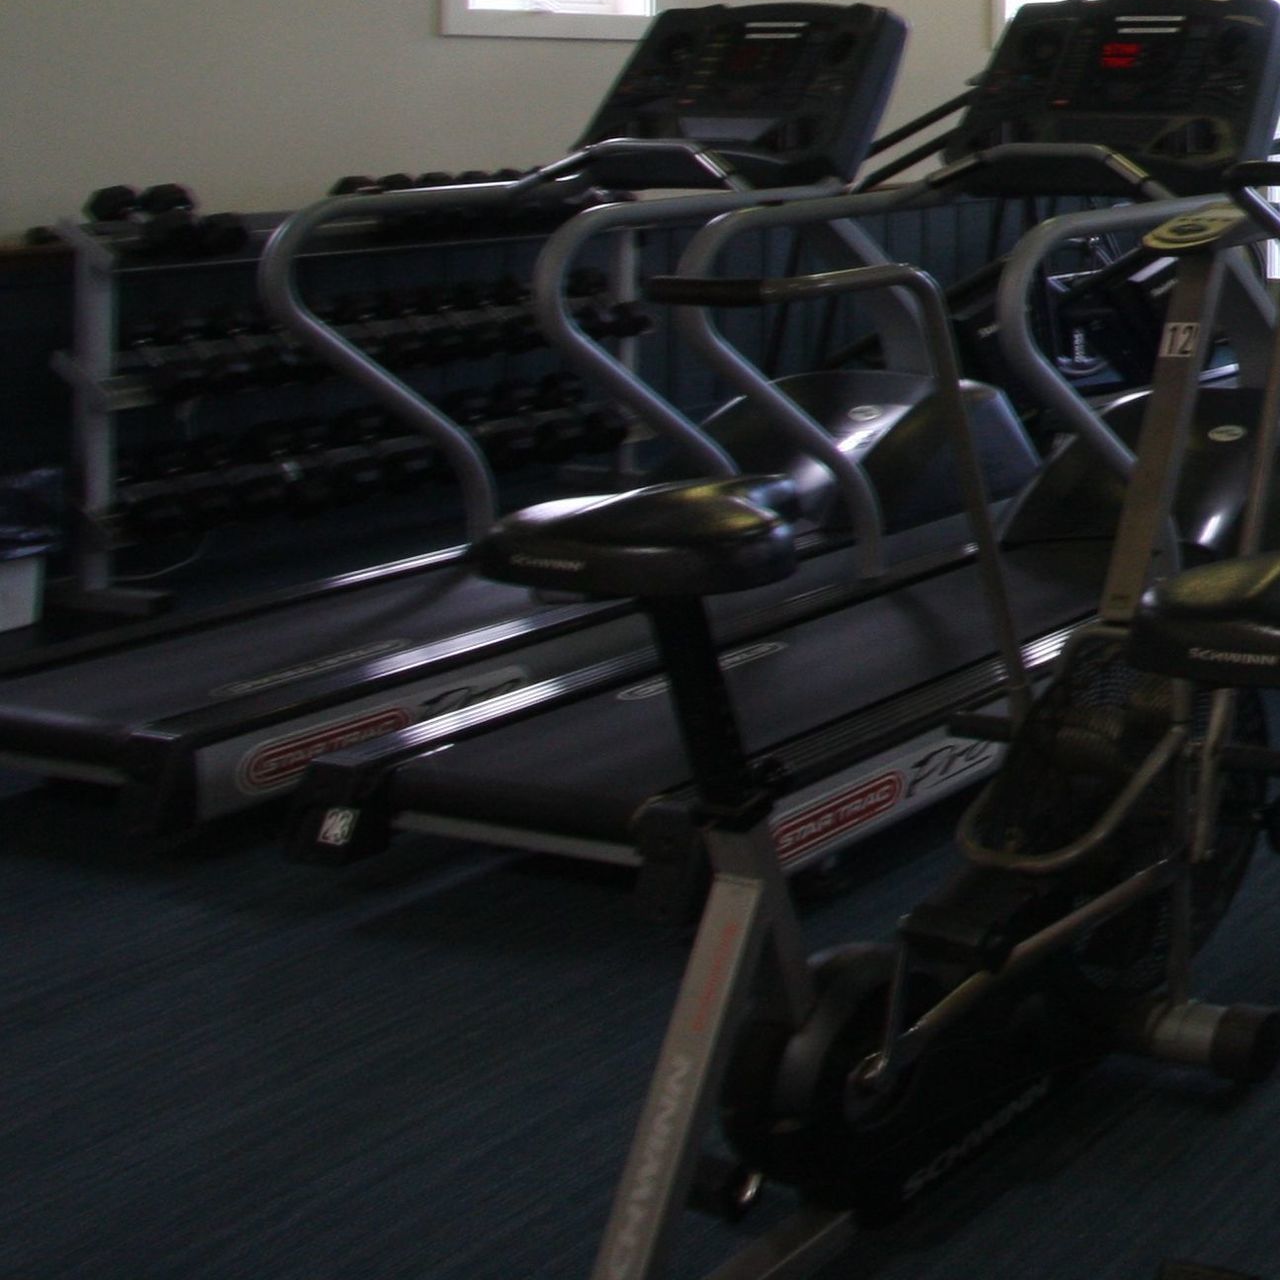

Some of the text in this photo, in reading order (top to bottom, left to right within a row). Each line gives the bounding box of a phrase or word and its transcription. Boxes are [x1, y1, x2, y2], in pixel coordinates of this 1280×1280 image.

[1167, 325, 1194, 355] 12
[1188, 647, 1280, 666] SCHWINN
[777, 812, 834, 848] STAR
[833, 783, 892, 825] TRAC
